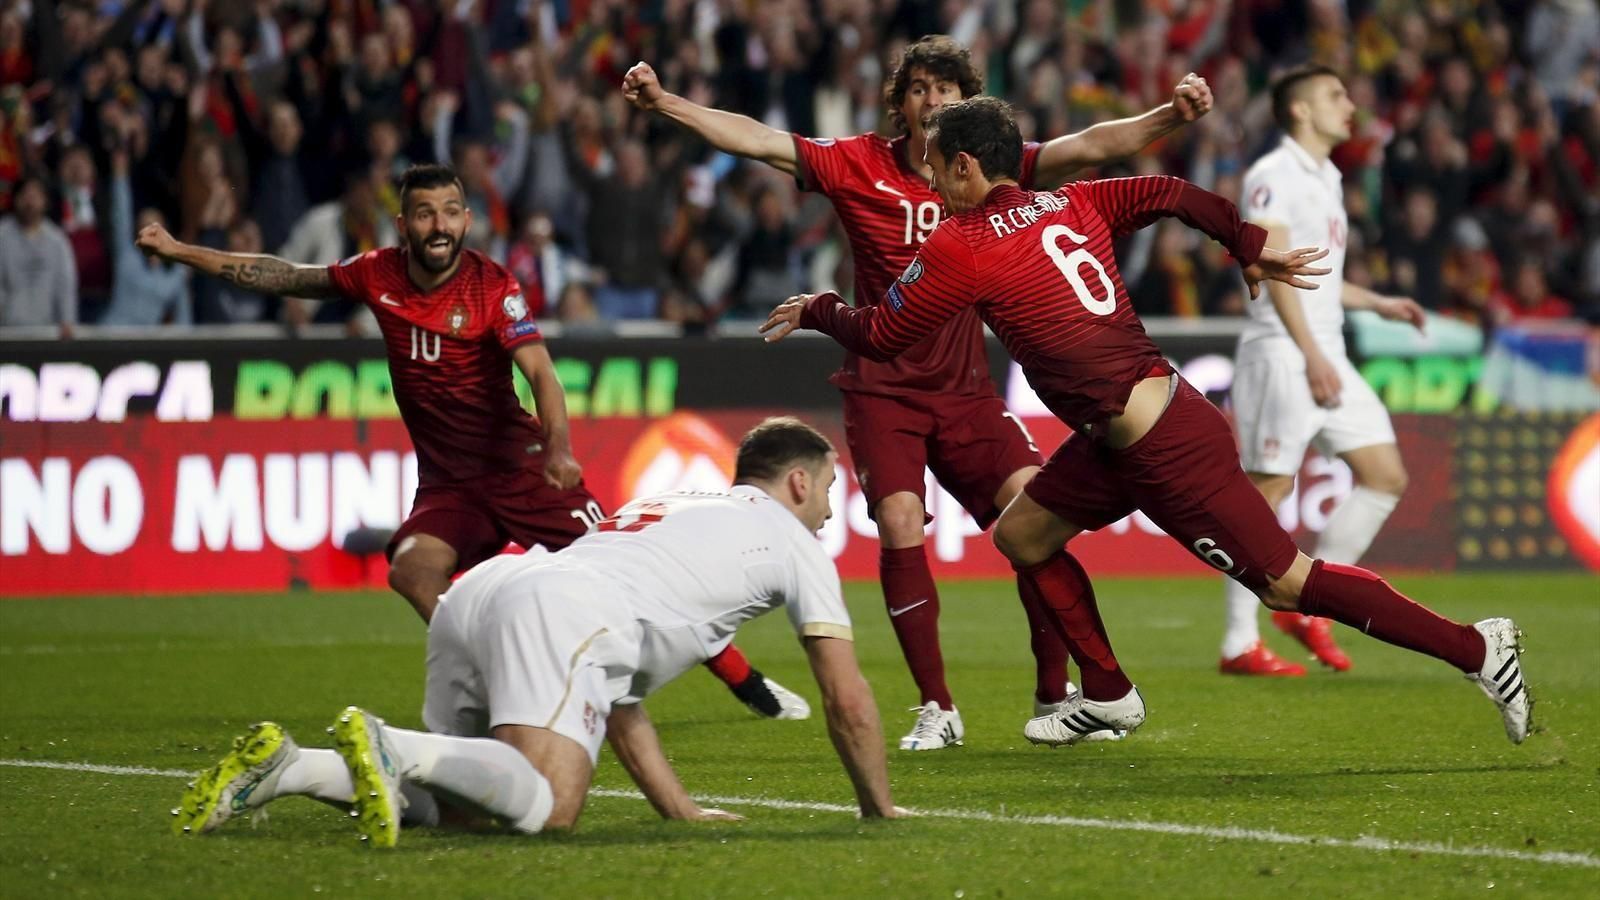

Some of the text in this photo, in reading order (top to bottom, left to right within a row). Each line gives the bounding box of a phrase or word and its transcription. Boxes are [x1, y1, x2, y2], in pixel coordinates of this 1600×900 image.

[899, 199, 940, 245] 19
[1042, 224, 1117, 316] 6
[410, 325, 441, 362] 10
[0, 450, 419, 555] NO MUN
[570, 500, 607, 530] 10
[1193, 537, 1234, 571] 6
